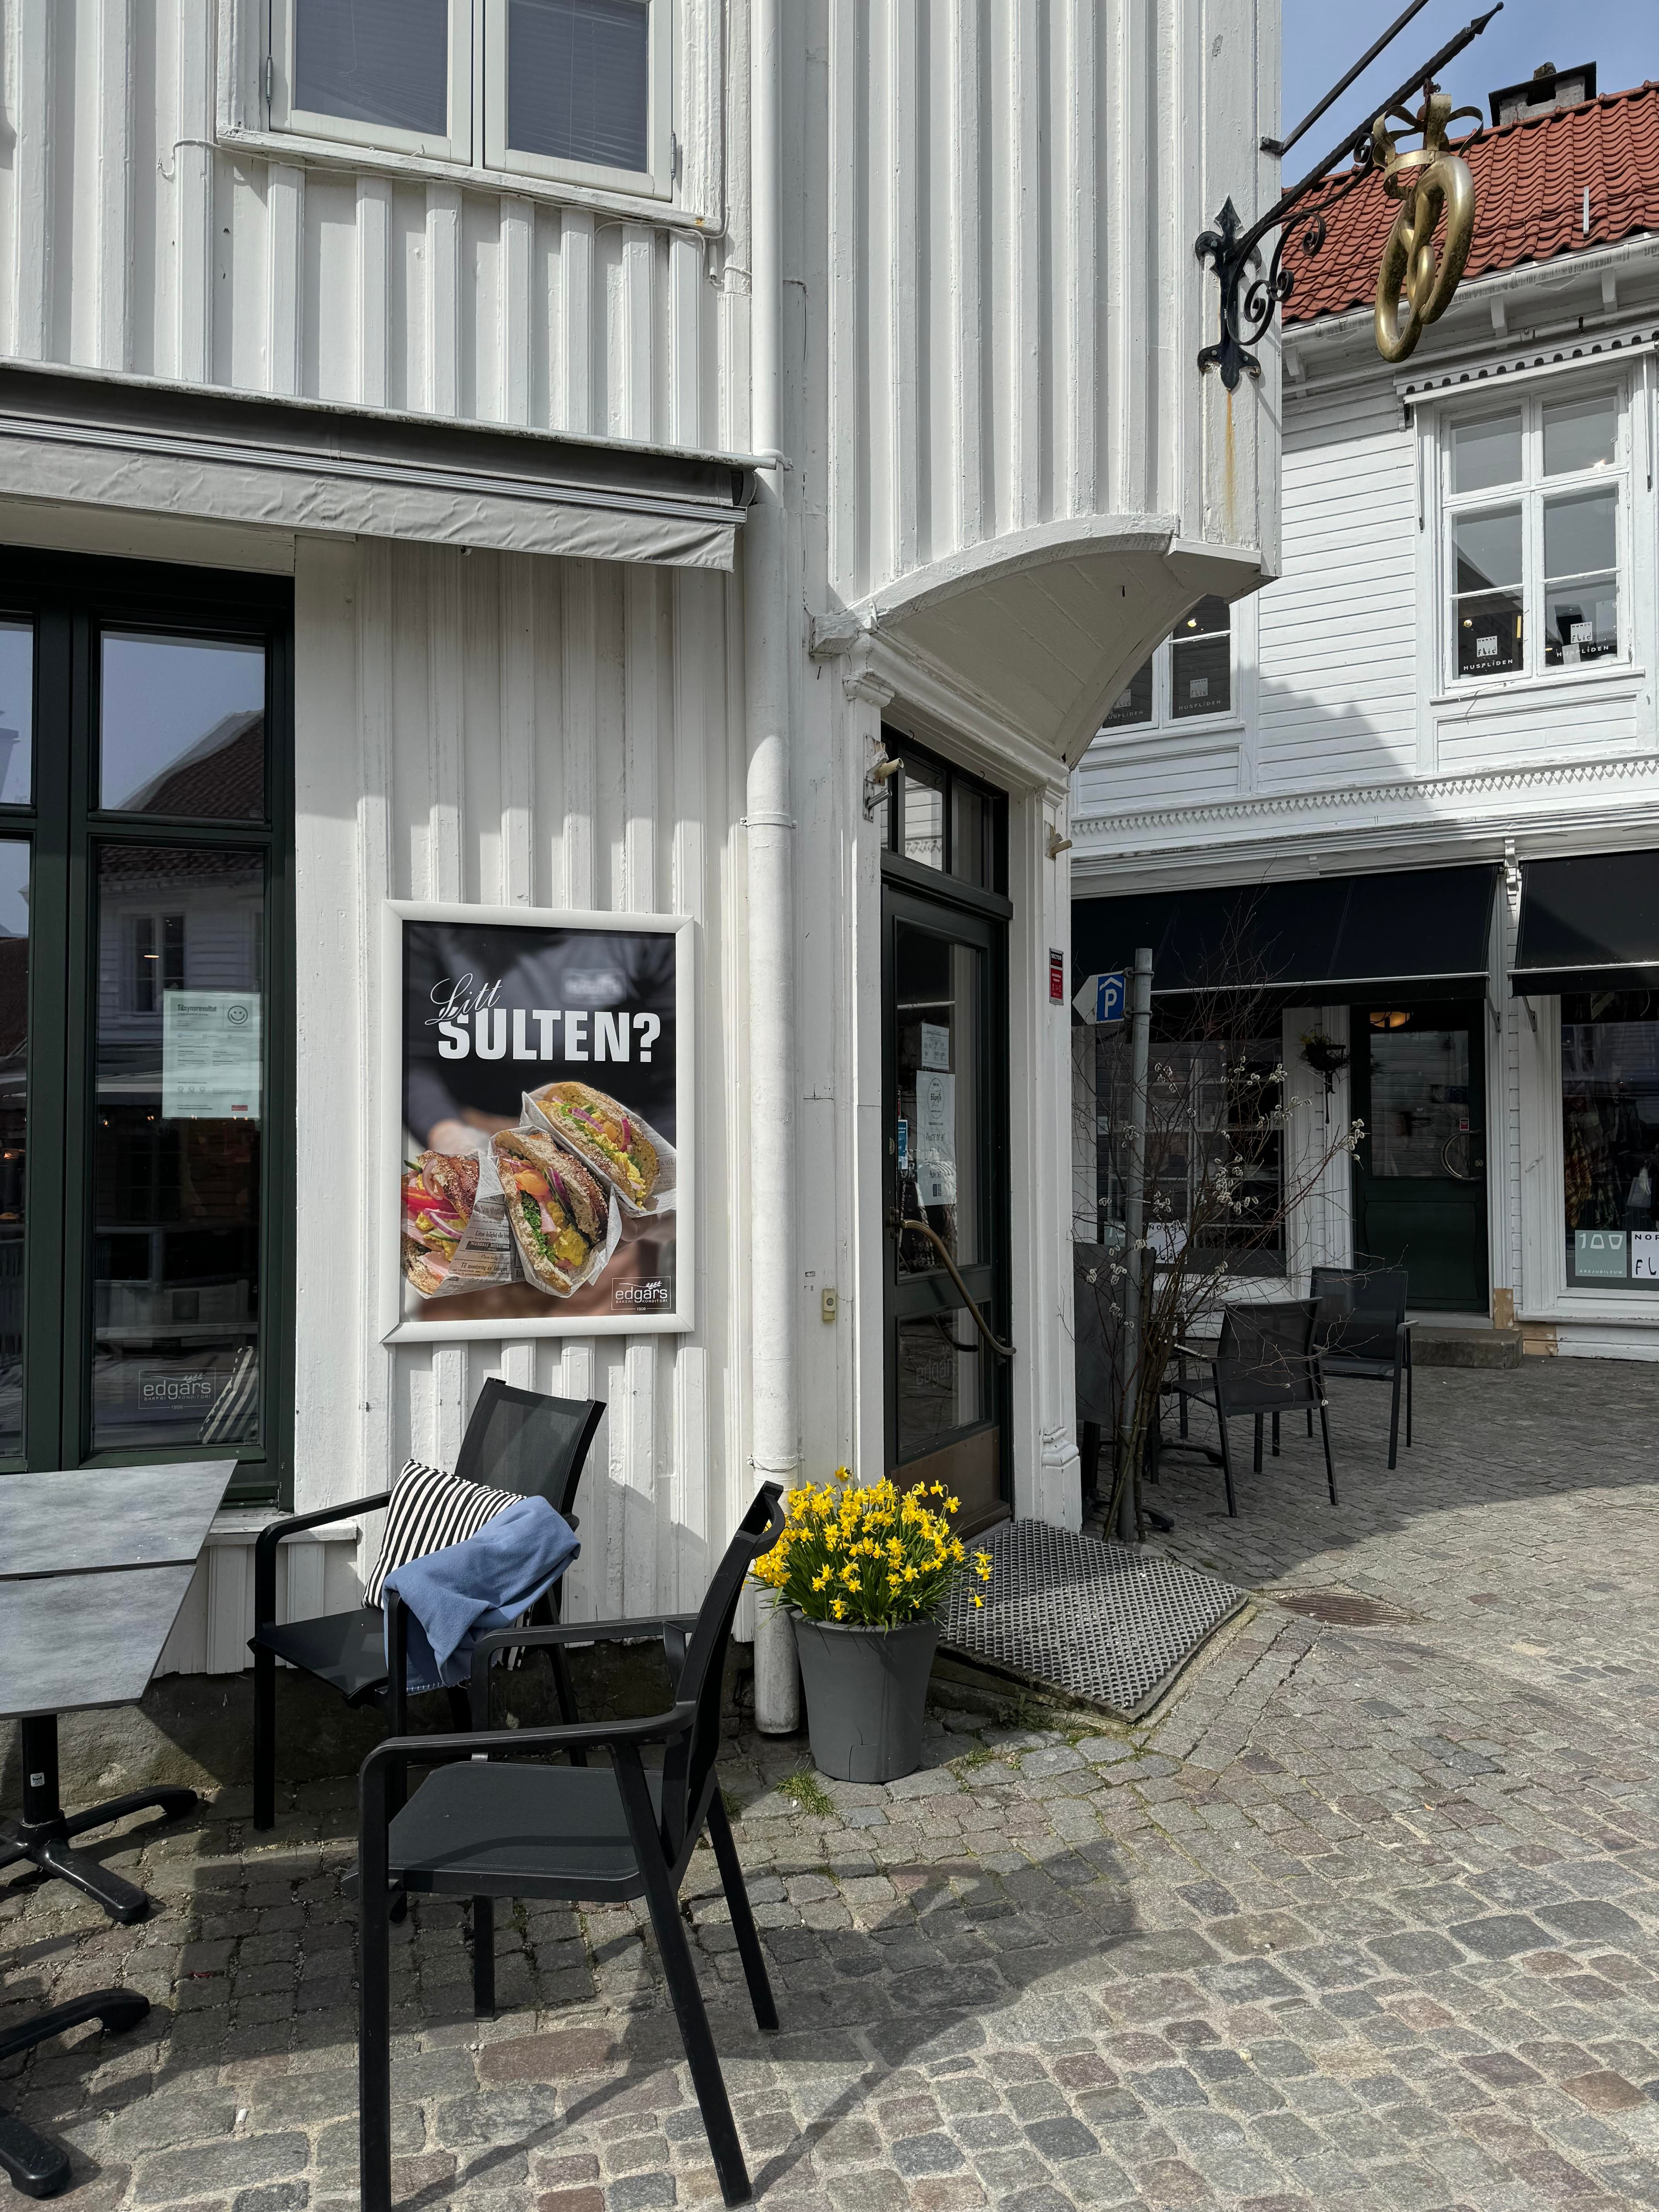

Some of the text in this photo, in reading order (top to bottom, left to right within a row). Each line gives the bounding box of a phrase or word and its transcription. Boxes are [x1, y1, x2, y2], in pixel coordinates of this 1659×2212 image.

[177, 1004, 217, 1013] Tilsynsresultat
[424, 973, 502, 1025] Litt
[1104, 988, 1117, 1018] P
[438, 1006, 661, 1062] SULTEN?
[1579, 1233, 1623, 1250] 100
[615, 1286, 668, 1303] edgars
[143, 1380, 211, 1400] edgars
